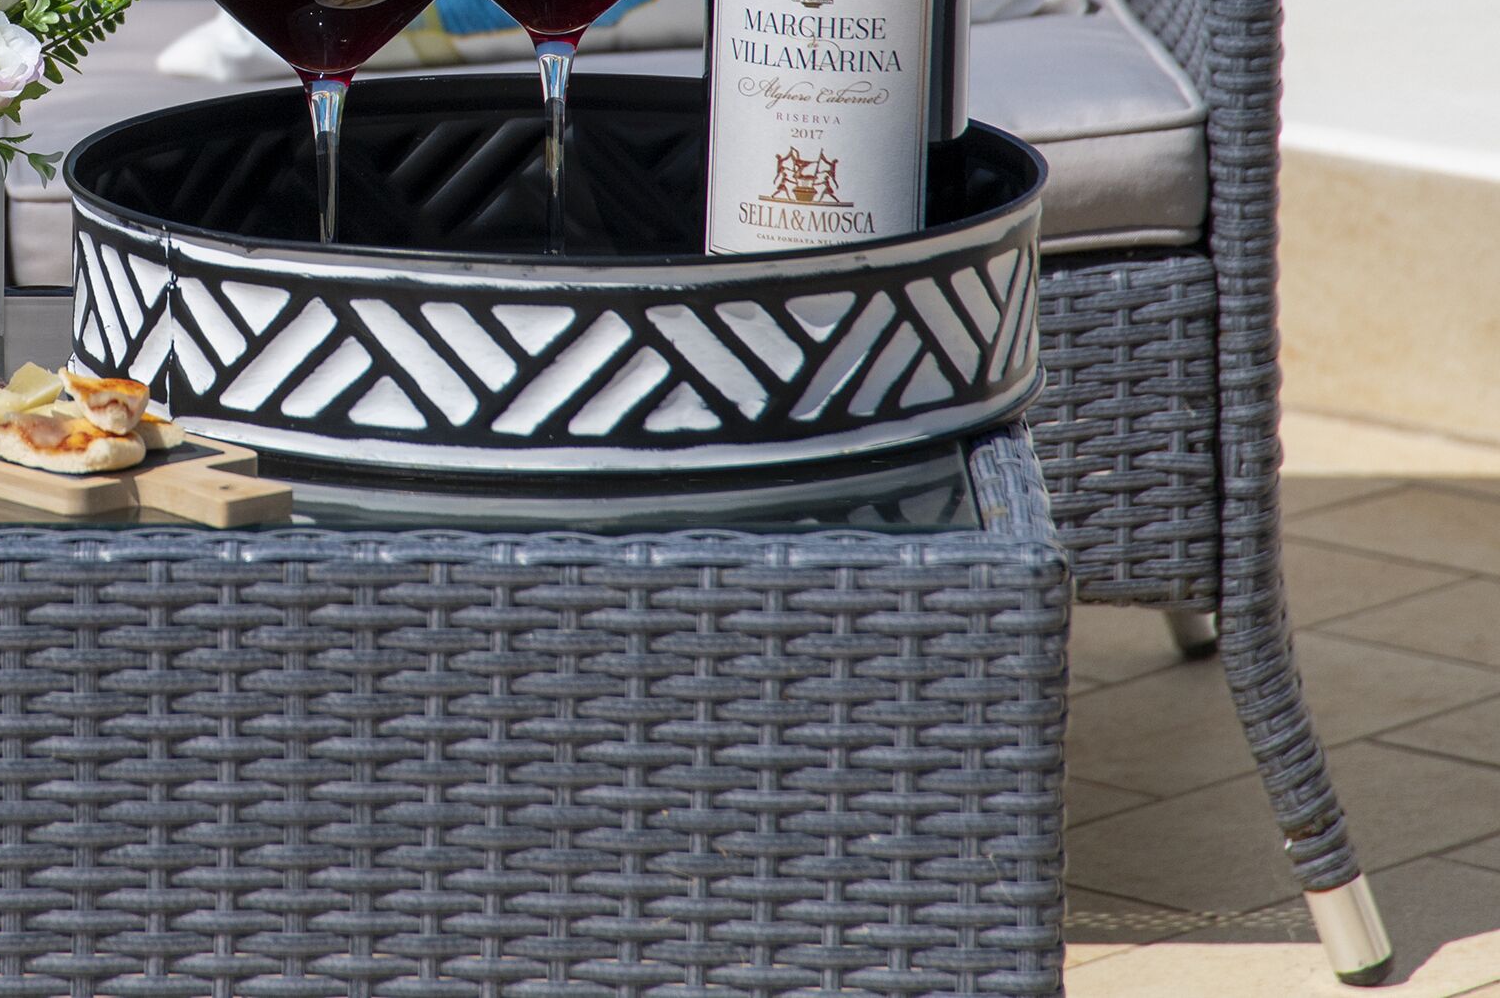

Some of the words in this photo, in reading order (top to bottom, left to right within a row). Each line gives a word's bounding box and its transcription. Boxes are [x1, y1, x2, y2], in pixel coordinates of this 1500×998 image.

[744, 8, 887, 40] MARCHESE
[731, 38, 902, 72] VILLAMARINA
[738, 76, 813, 110] Alghero
[815, 80, 890, 105] Cabernet
[776, 112, 841, 125] RISERVA
[790, 128, 824, 140] 2017
